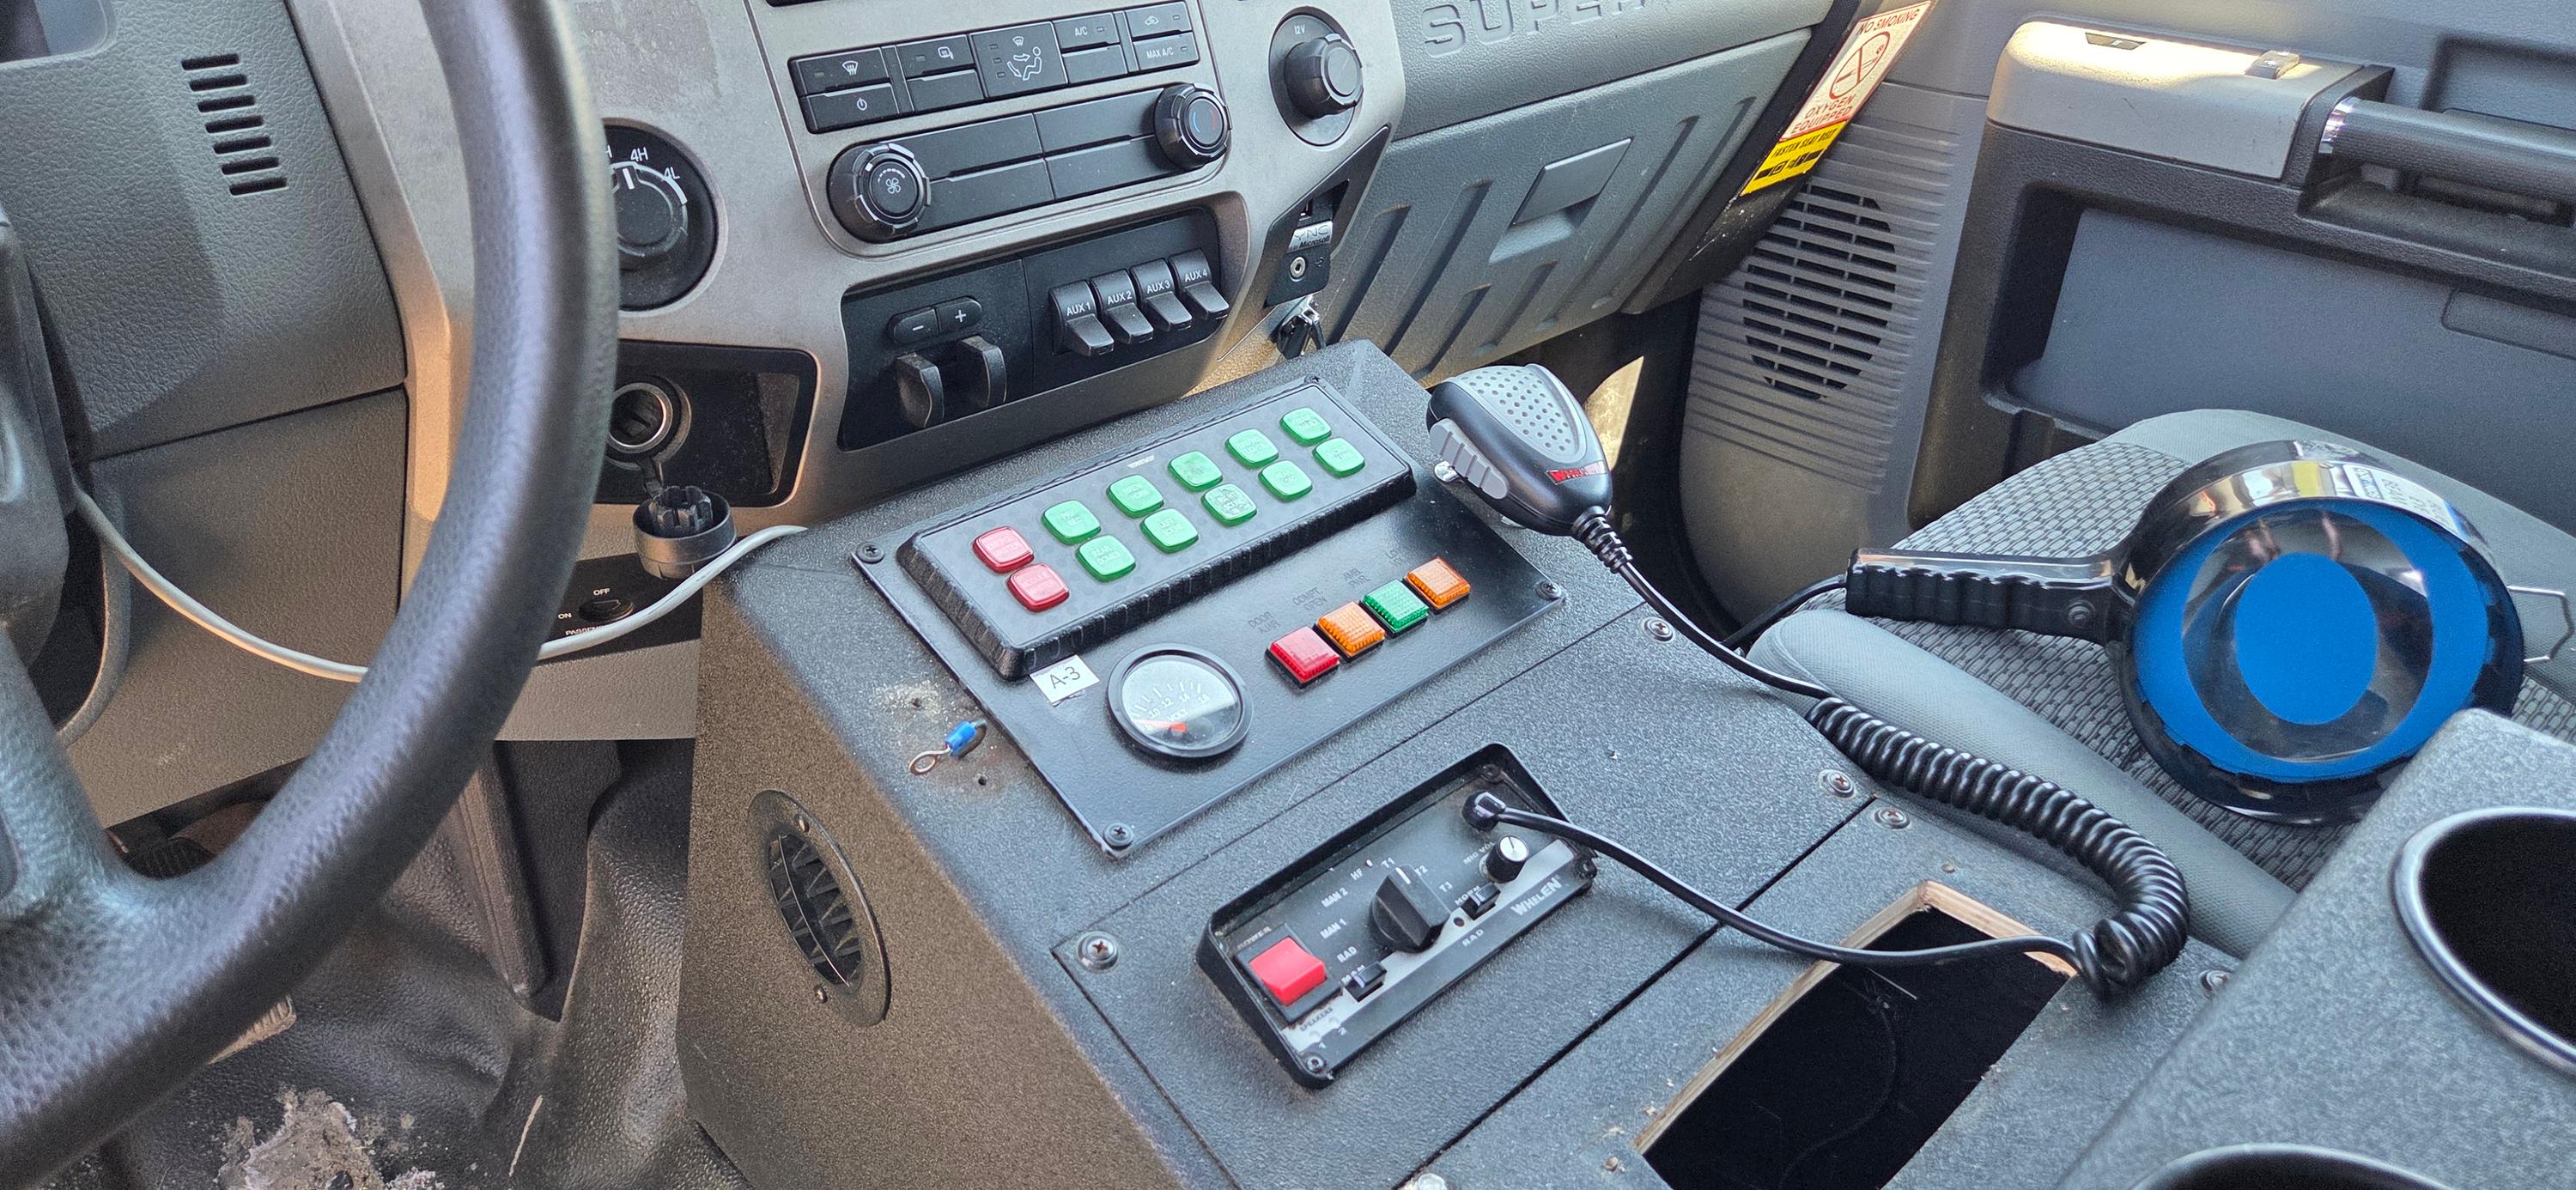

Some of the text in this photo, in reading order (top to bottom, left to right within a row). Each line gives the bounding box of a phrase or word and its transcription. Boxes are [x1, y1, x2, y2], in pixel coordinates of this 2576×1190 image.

[1294, 24, 1305, 35] 12V
[1857, 9, 1920, 35] NO SMOKING
[1074, 26, 1088, 37] A/C
[1146, 46, 1175, 59] MAX A/C
[1805, 94, 1856, 118] OXYGEN
[1791, 106, 1853, 134] EQUIPPED
[1771, 128, 1838, 158] FASTEN SEAT BELT
[629, 146, 648, 162] 4H
[664, 167, 680, 181] 4L
[1293, 224, 1329, 241] YNC
[1183, 268, 1209, 282] AUX 4
[1146, 280, 1171, 294] AUX 3
[1107, 290, 1133, 305] AUX 2
[1066, 301, 1091, 316] AUX 1
[593, 587, 611, 596] OFF
[1248, 610, 1276, 628] DOOR
[1049, 666, 1080, 689] A-3
[1161, 697, 1174, 708] 12
[1179, 693, 1190, 702] 14
[1148, 707, 1161, 719] 10
[1463, 841, 1496, 865] MIC VOL
[1381, 857, 1395, 869] T1
[1350, 868, 1364, 881] HF
[1414, 865, 1429, 877] T2
[1438, 881, 1453, 893] T3
[1321, 887, 1349, 908] MAN 2
[1510, 876, 1563, 916] WHELEN
[1320, 918, 1347, 939] MAN 1
[1237, 926, 1272, 950] POWER
[1461, 928, 1485, 947] RAD
[1336, 946, 1358, 963] RAD
[1338, 1027, 1347, 1035] 2
